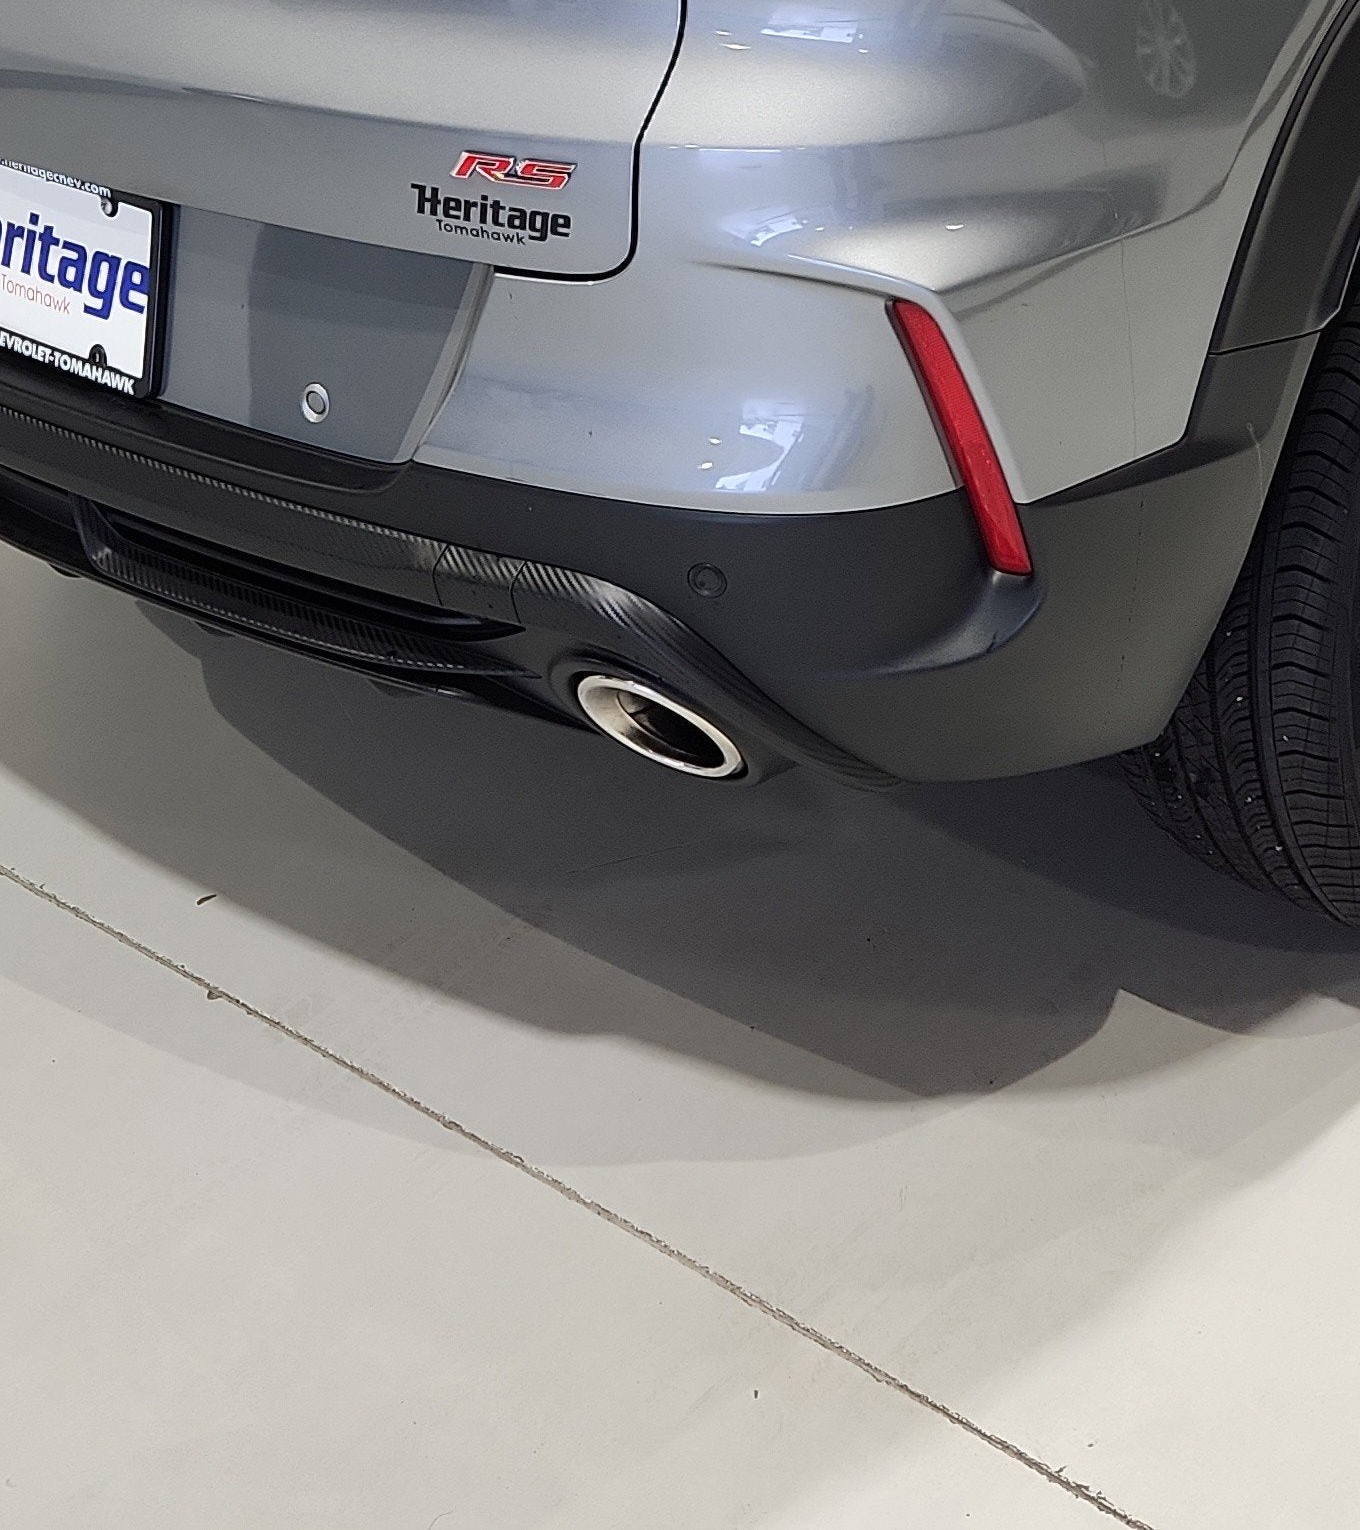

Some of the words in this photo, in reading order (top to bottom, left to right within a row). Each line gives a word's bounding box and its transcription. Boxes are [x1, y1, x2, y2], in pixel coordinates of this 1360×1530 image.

[450, 150, 578, 190] RS
[411, 183, 571, 242] Heritage
[436, 219, 526, 246] Tomahawk
[0, 273, 71, 315] Tomahawk
